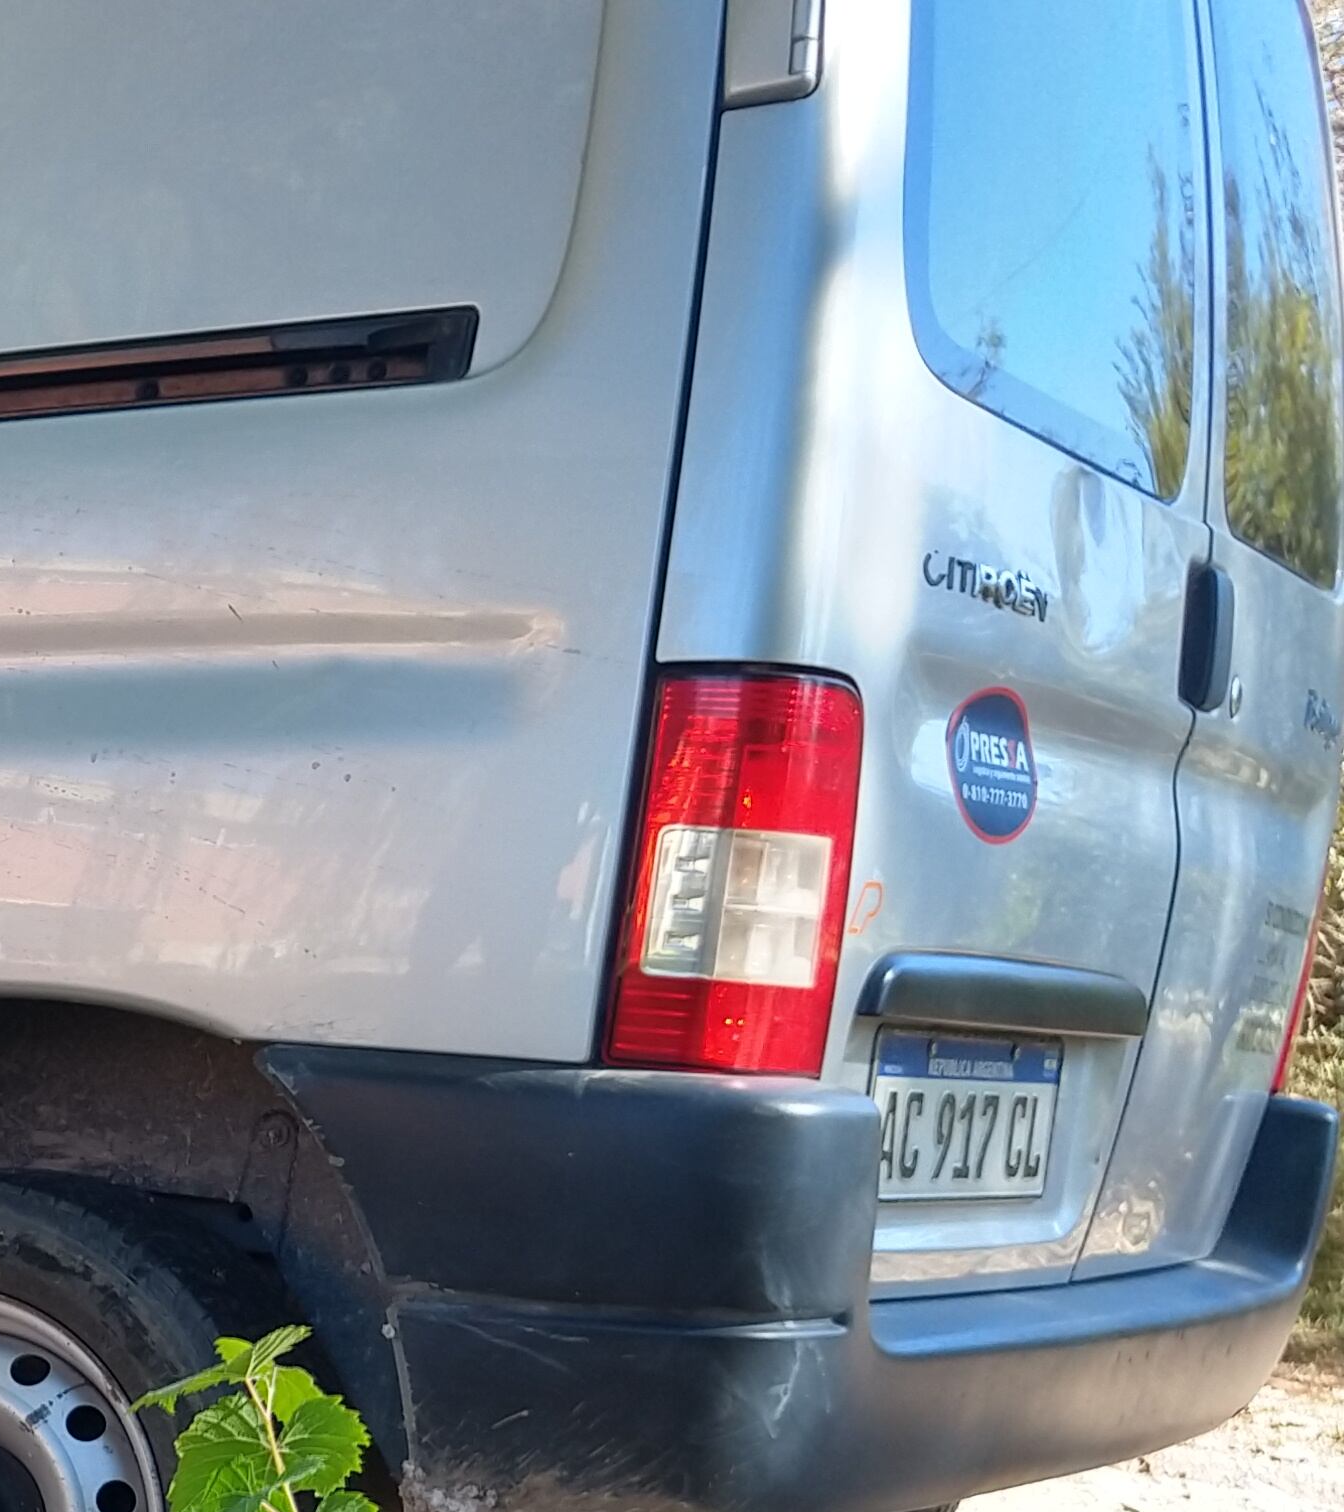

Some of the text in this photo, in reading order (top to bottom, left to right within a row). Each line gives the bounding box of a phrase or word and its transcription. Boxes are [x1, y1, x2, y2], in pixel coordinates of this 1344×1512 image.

[923, 549, 1048, 622] CITROËN
[880, 1090, 1041, 1180] AC 917 CL
